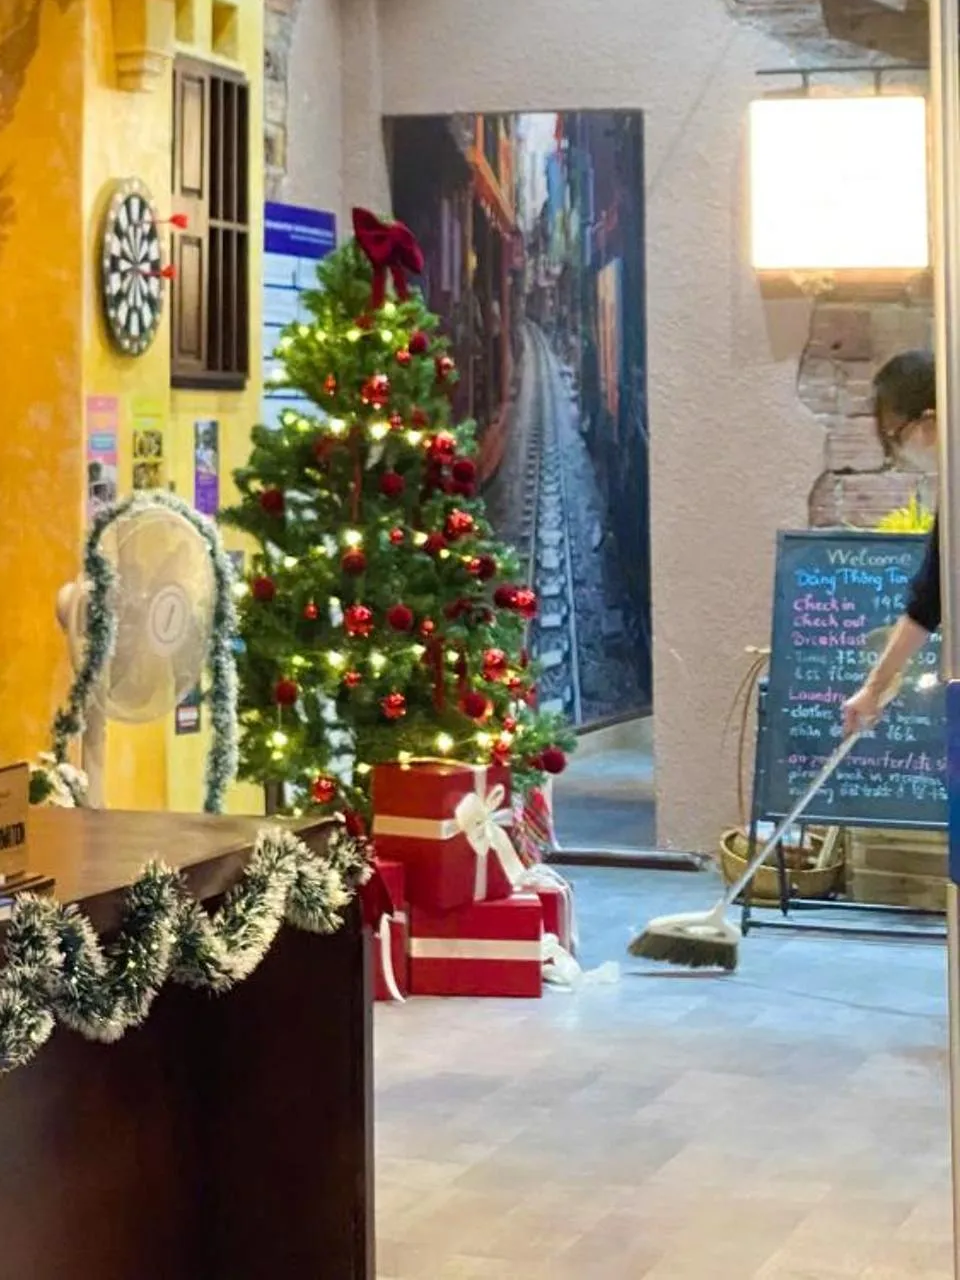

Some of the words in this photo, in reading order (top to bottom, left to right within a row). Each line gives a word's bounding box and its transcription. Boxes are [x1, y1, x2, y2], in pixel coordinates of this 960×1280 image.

[826, 549, 912, 565] Welcome
[841, 597, 856, 610] in
[842, 614, 867, 629] out
